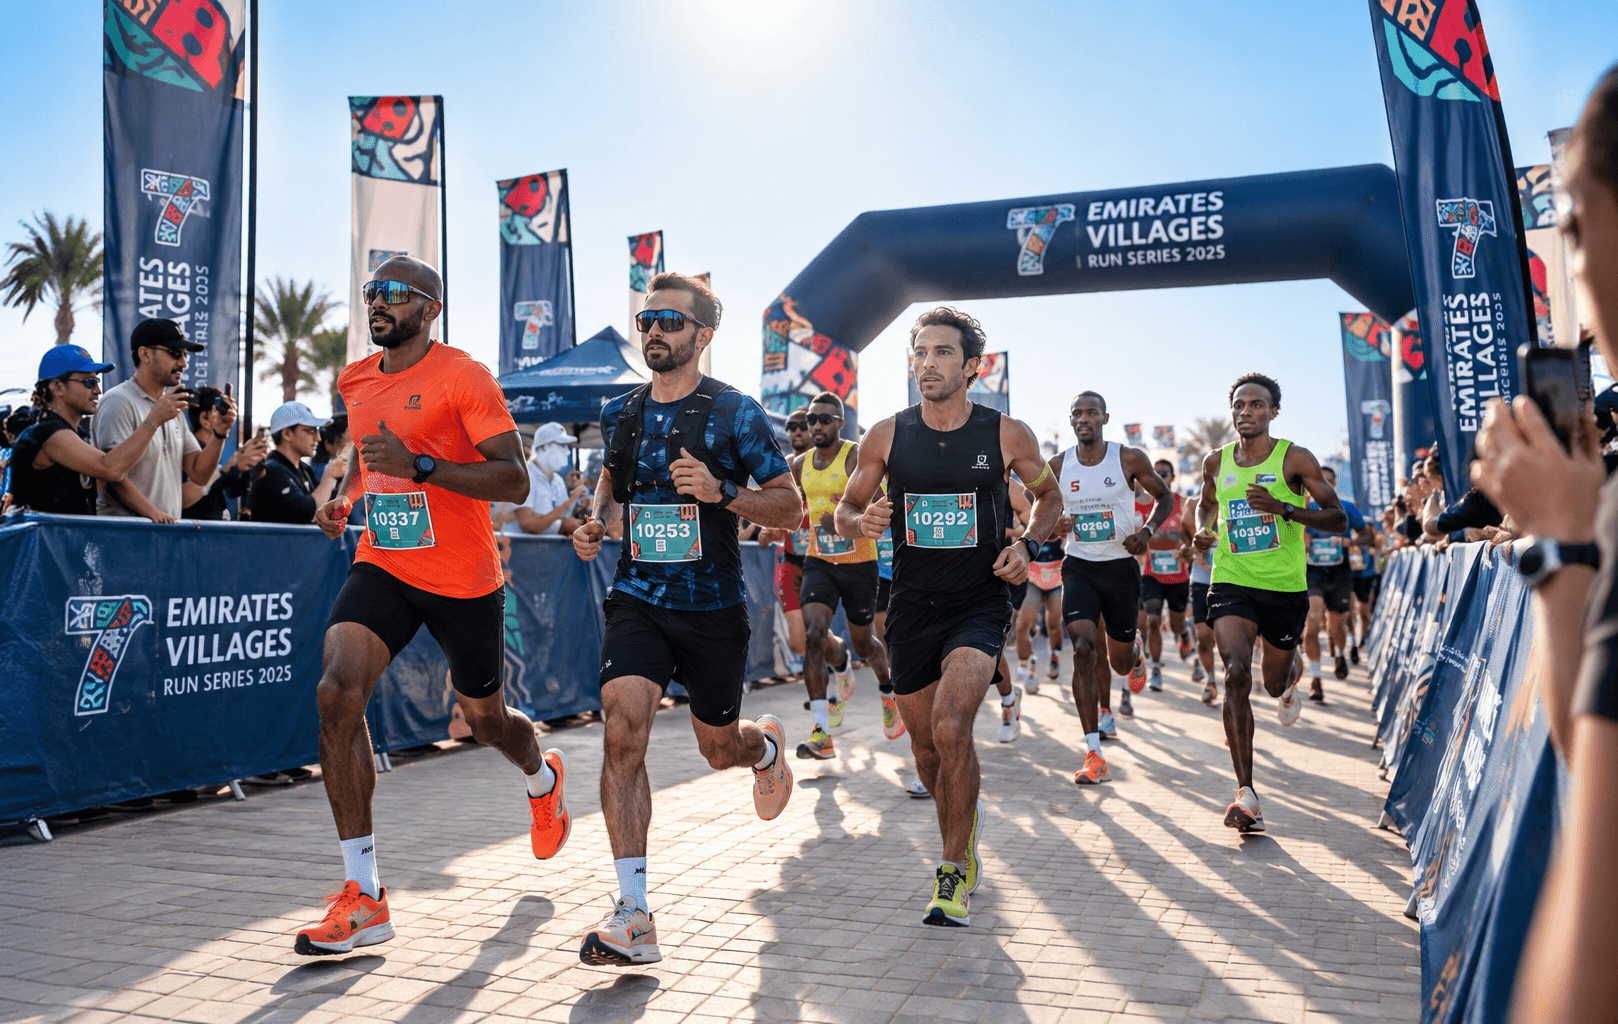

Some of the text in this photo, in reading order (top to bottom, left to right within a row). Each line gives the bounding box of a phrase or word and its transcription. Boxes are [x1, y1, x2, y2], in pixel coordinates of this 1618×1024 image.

[1087, 190, 1224, 222] EMIRATES
[1085, 214, 1225, 249] VILLAGES
[1087, 244, 1226, 269] RUN SERIES 2025
[1449, 293, 1478, 432] EMIRATES
[1469, 292, 1500, 428] LLAGES
[372, 511, 420, 526] 10337
[635, 523, 691, 538] 10253
[912, 511, 969, 526] 10292
[1232, 525, 1271, 539] 10350
[166, 592, 294, 628] EMIRATES
[165, 627, 292, 667] VILLAGES
[163, 664, 292, 696] RUN SERIES 2025
